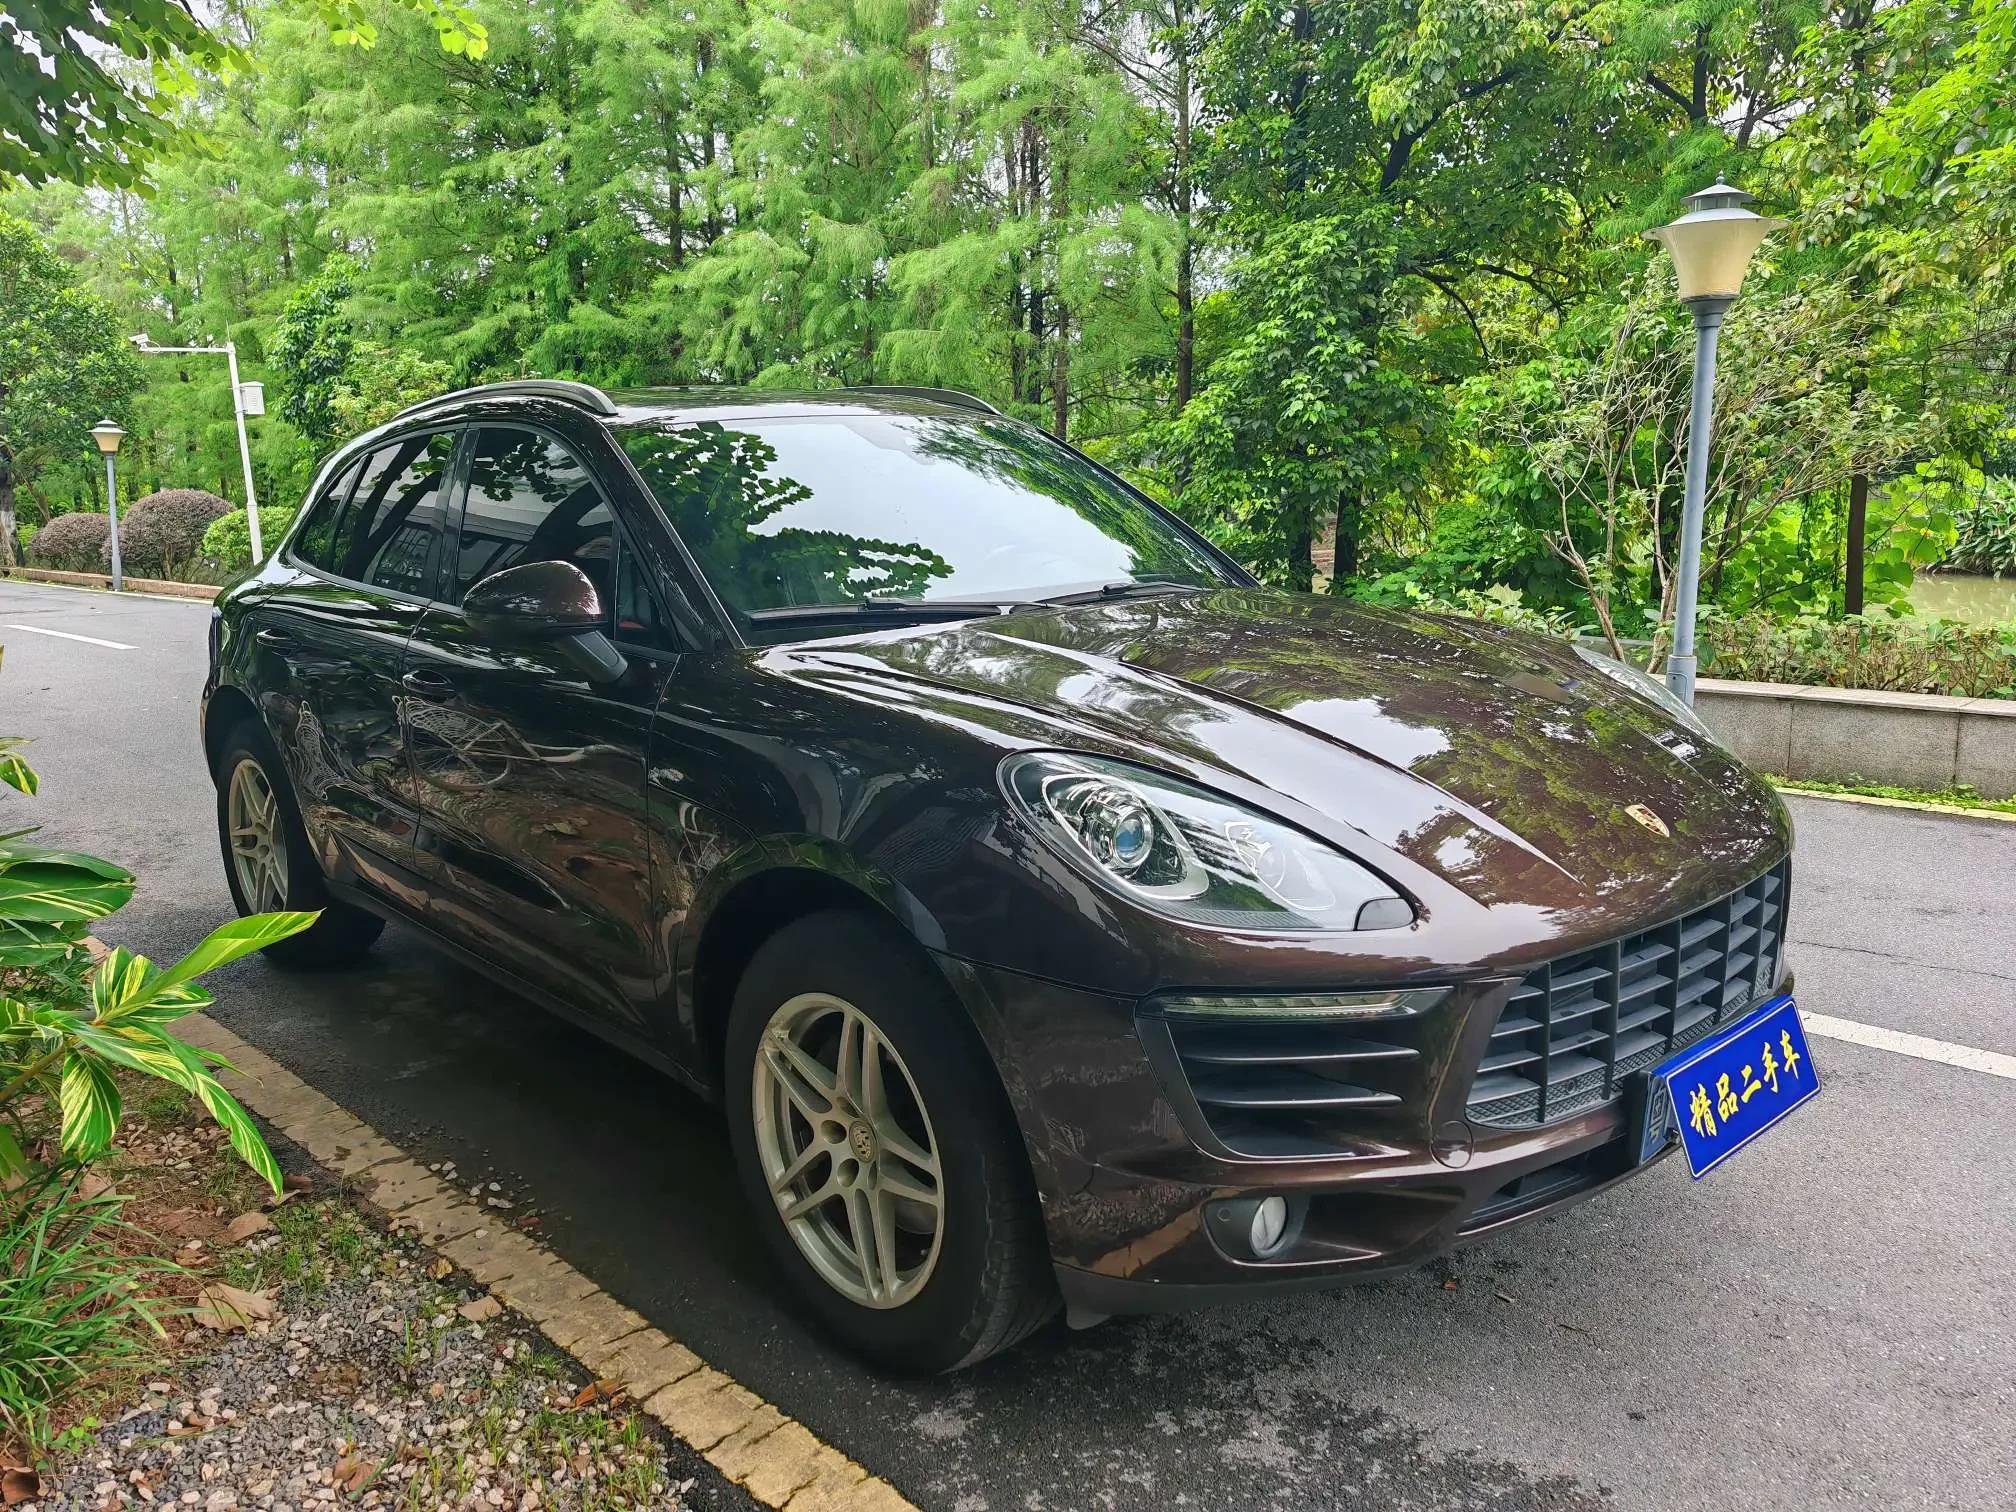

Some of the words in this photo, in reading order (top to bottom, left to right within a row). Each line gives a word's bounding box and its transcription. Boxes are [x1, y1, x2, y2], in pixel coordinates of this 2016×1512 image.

[1690, 1029, 1800, 1138] 精品二手车
